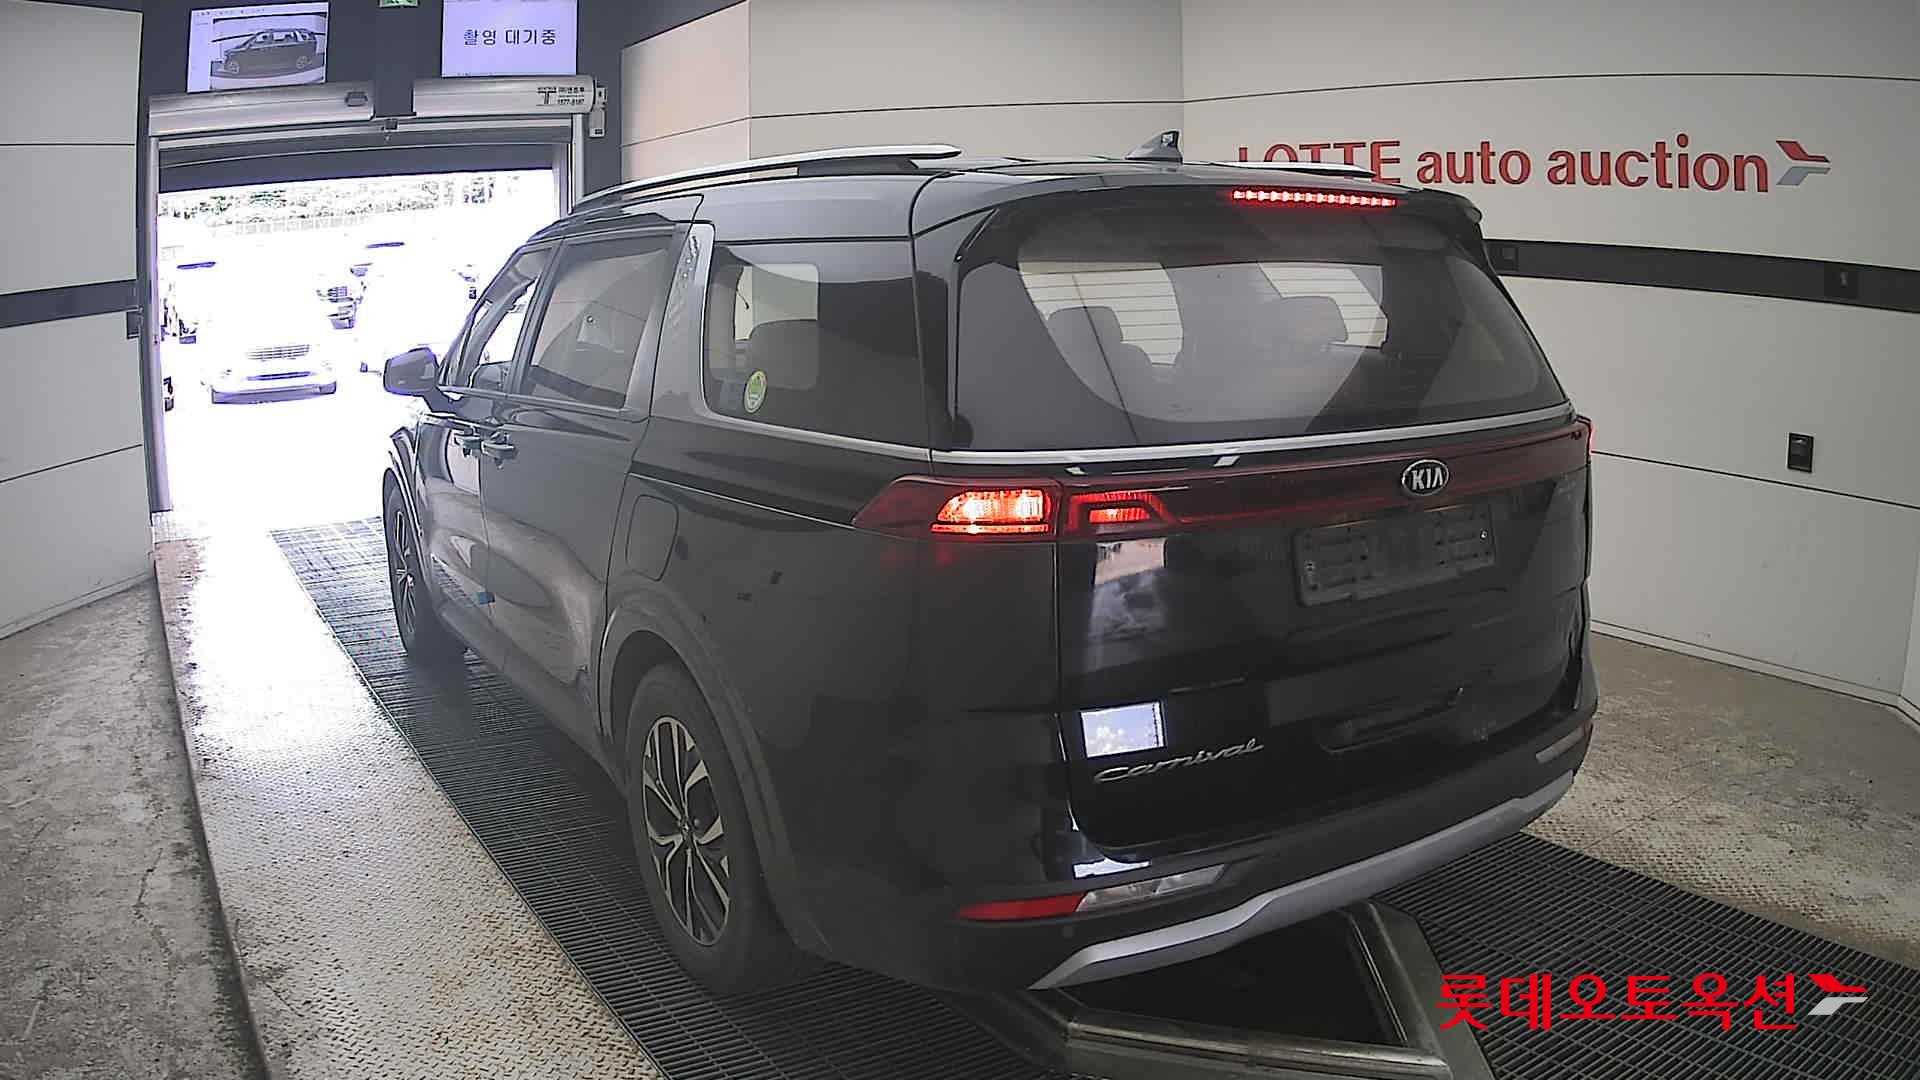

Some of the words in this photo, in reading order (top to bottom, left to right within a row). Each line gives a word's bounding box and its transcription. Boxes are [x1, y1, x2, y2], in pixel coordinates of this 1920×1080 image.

[505, 29, 557, 46] 대기중
[1416, 141, 1532, 185] auto
[1547, 134, 1769, 192] auction
[1411, 467, 1443, 491] KIA
[1094, 738, 1265, 783] Carnival
